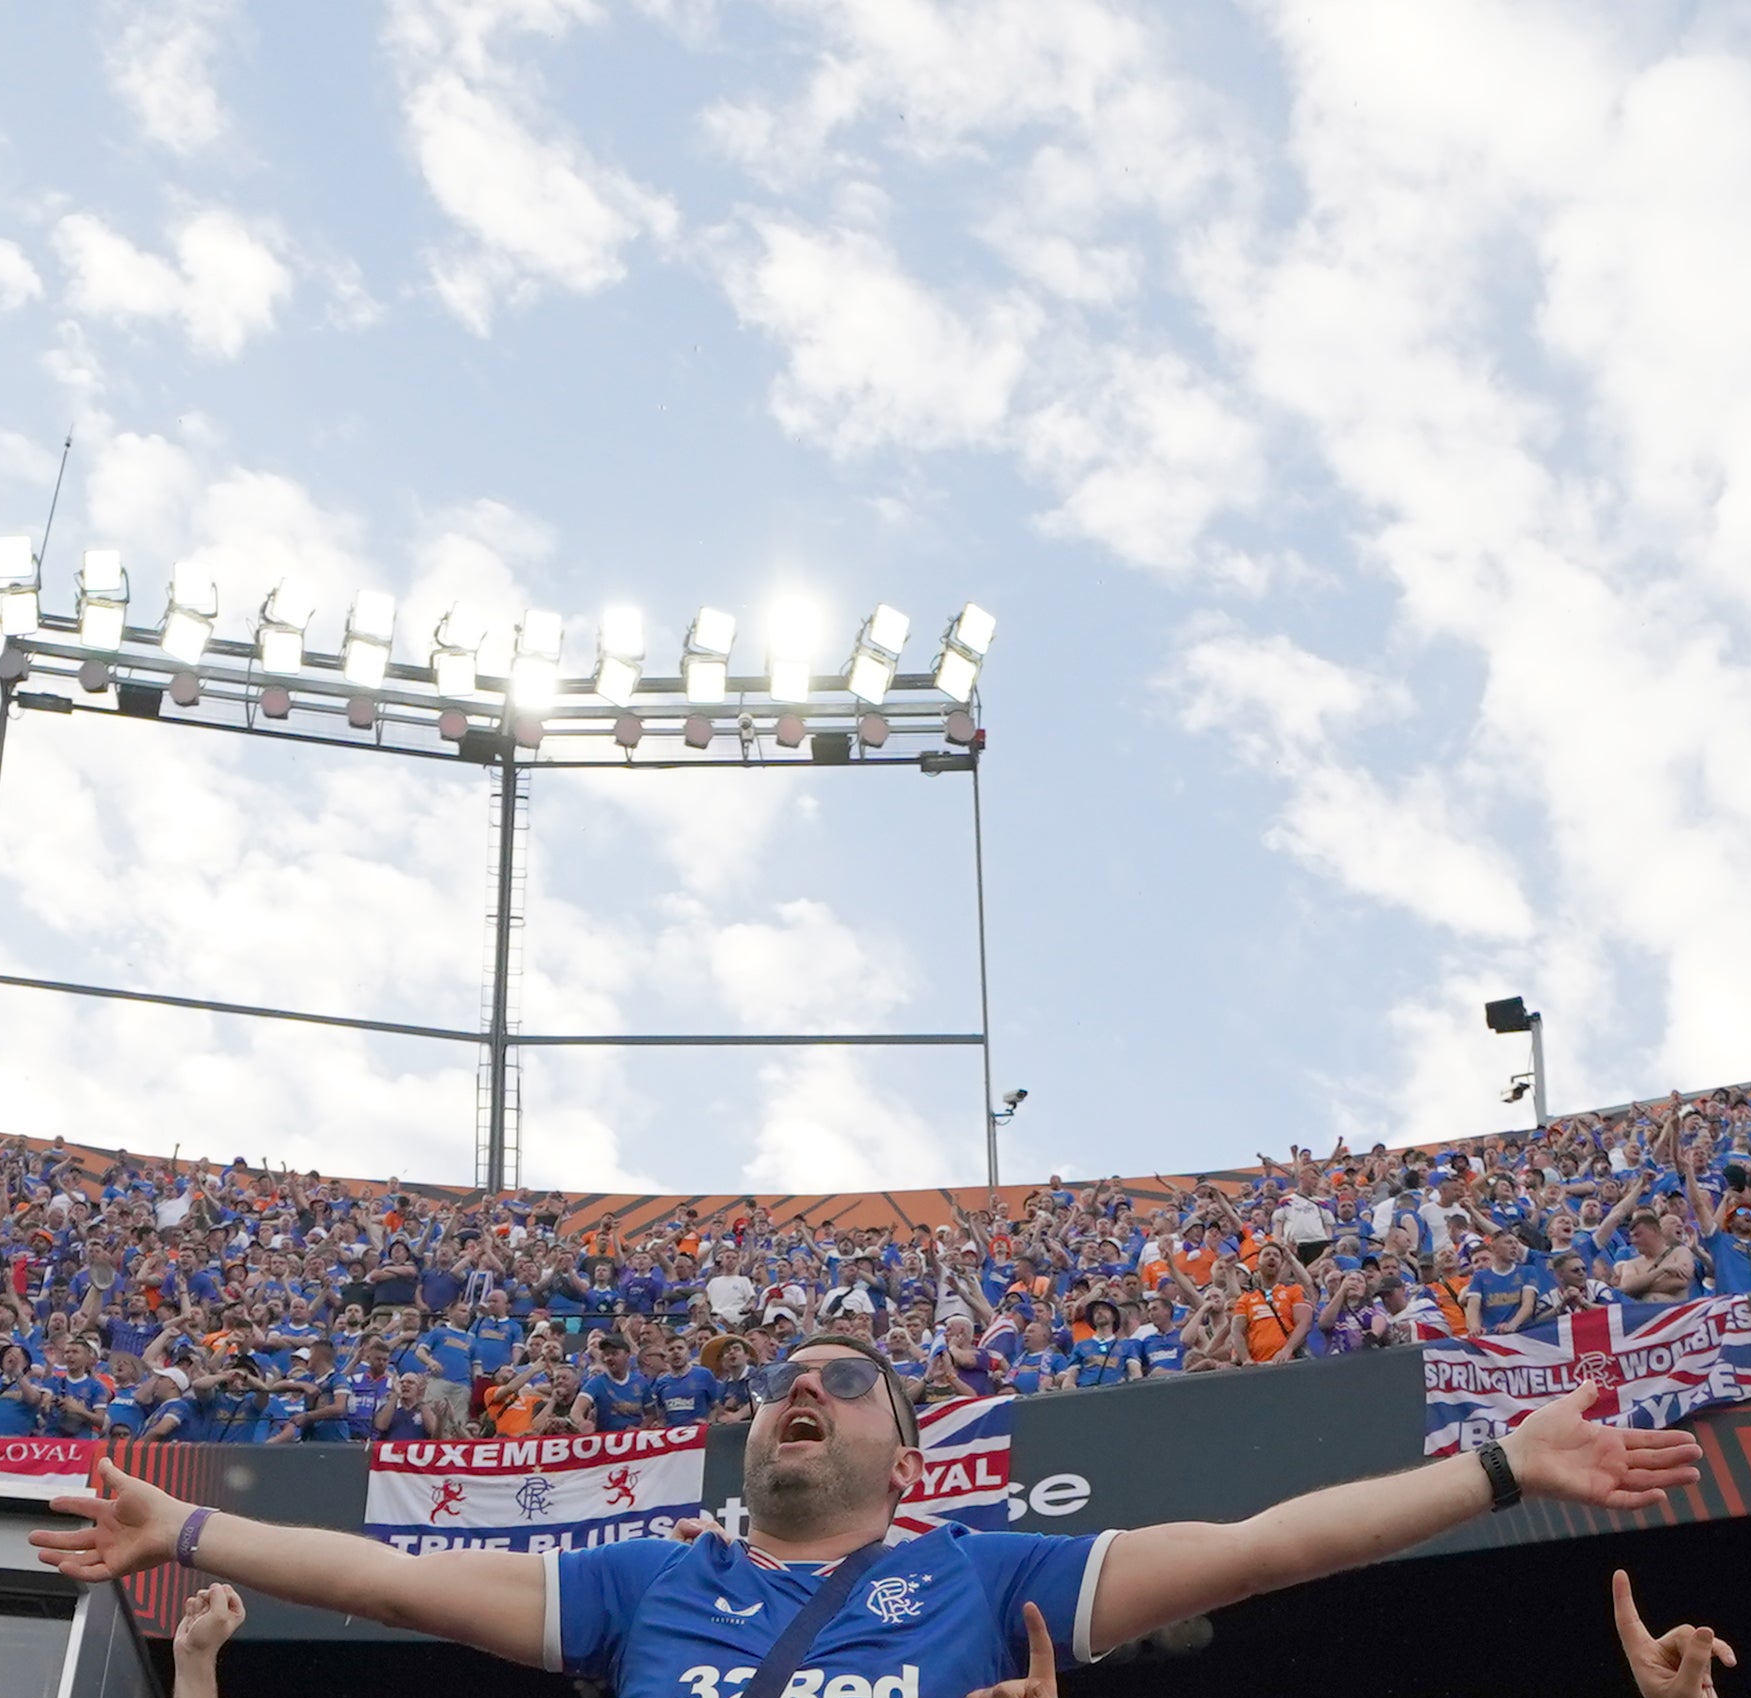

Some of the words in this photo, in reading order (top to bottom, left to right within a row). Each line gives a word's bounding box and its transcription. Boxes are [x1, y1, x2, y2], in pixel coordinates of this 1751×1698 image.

[1424, 1362, 1578, 1397] SPRINGWELL
[378, 1425, 699, 1467] LUXEMBOURG
[910, 1457, 1004, 1498] YAL
